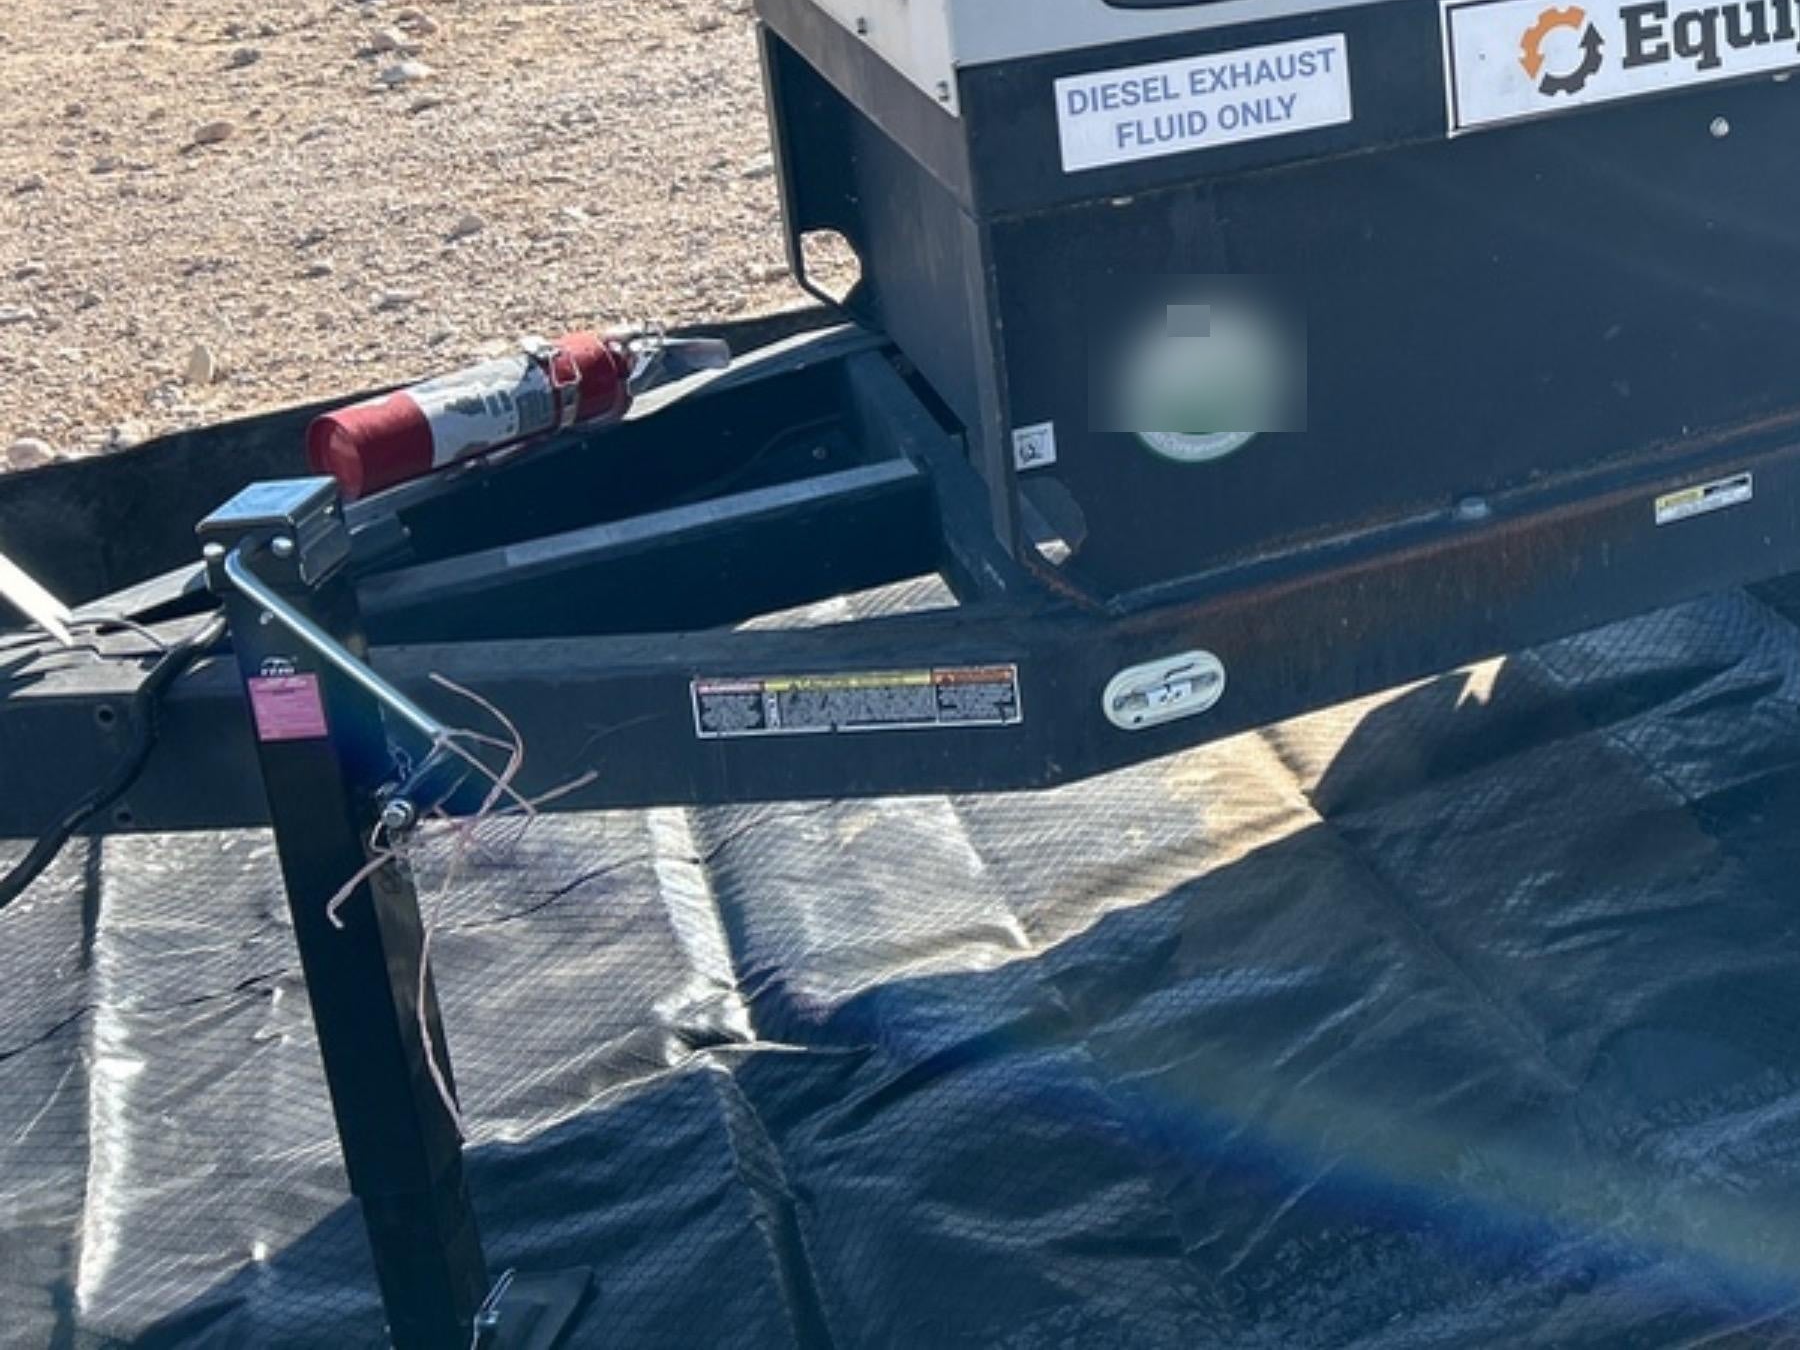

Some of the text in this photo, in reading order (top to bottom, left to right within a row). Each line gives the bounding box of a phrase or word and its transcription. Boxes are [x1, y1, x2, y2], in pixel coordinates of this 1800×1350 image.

[1066, 47, 1336, 116] DIESEL EXHAUST
[1115, 92, 1298, 149] FLUID ONLY
